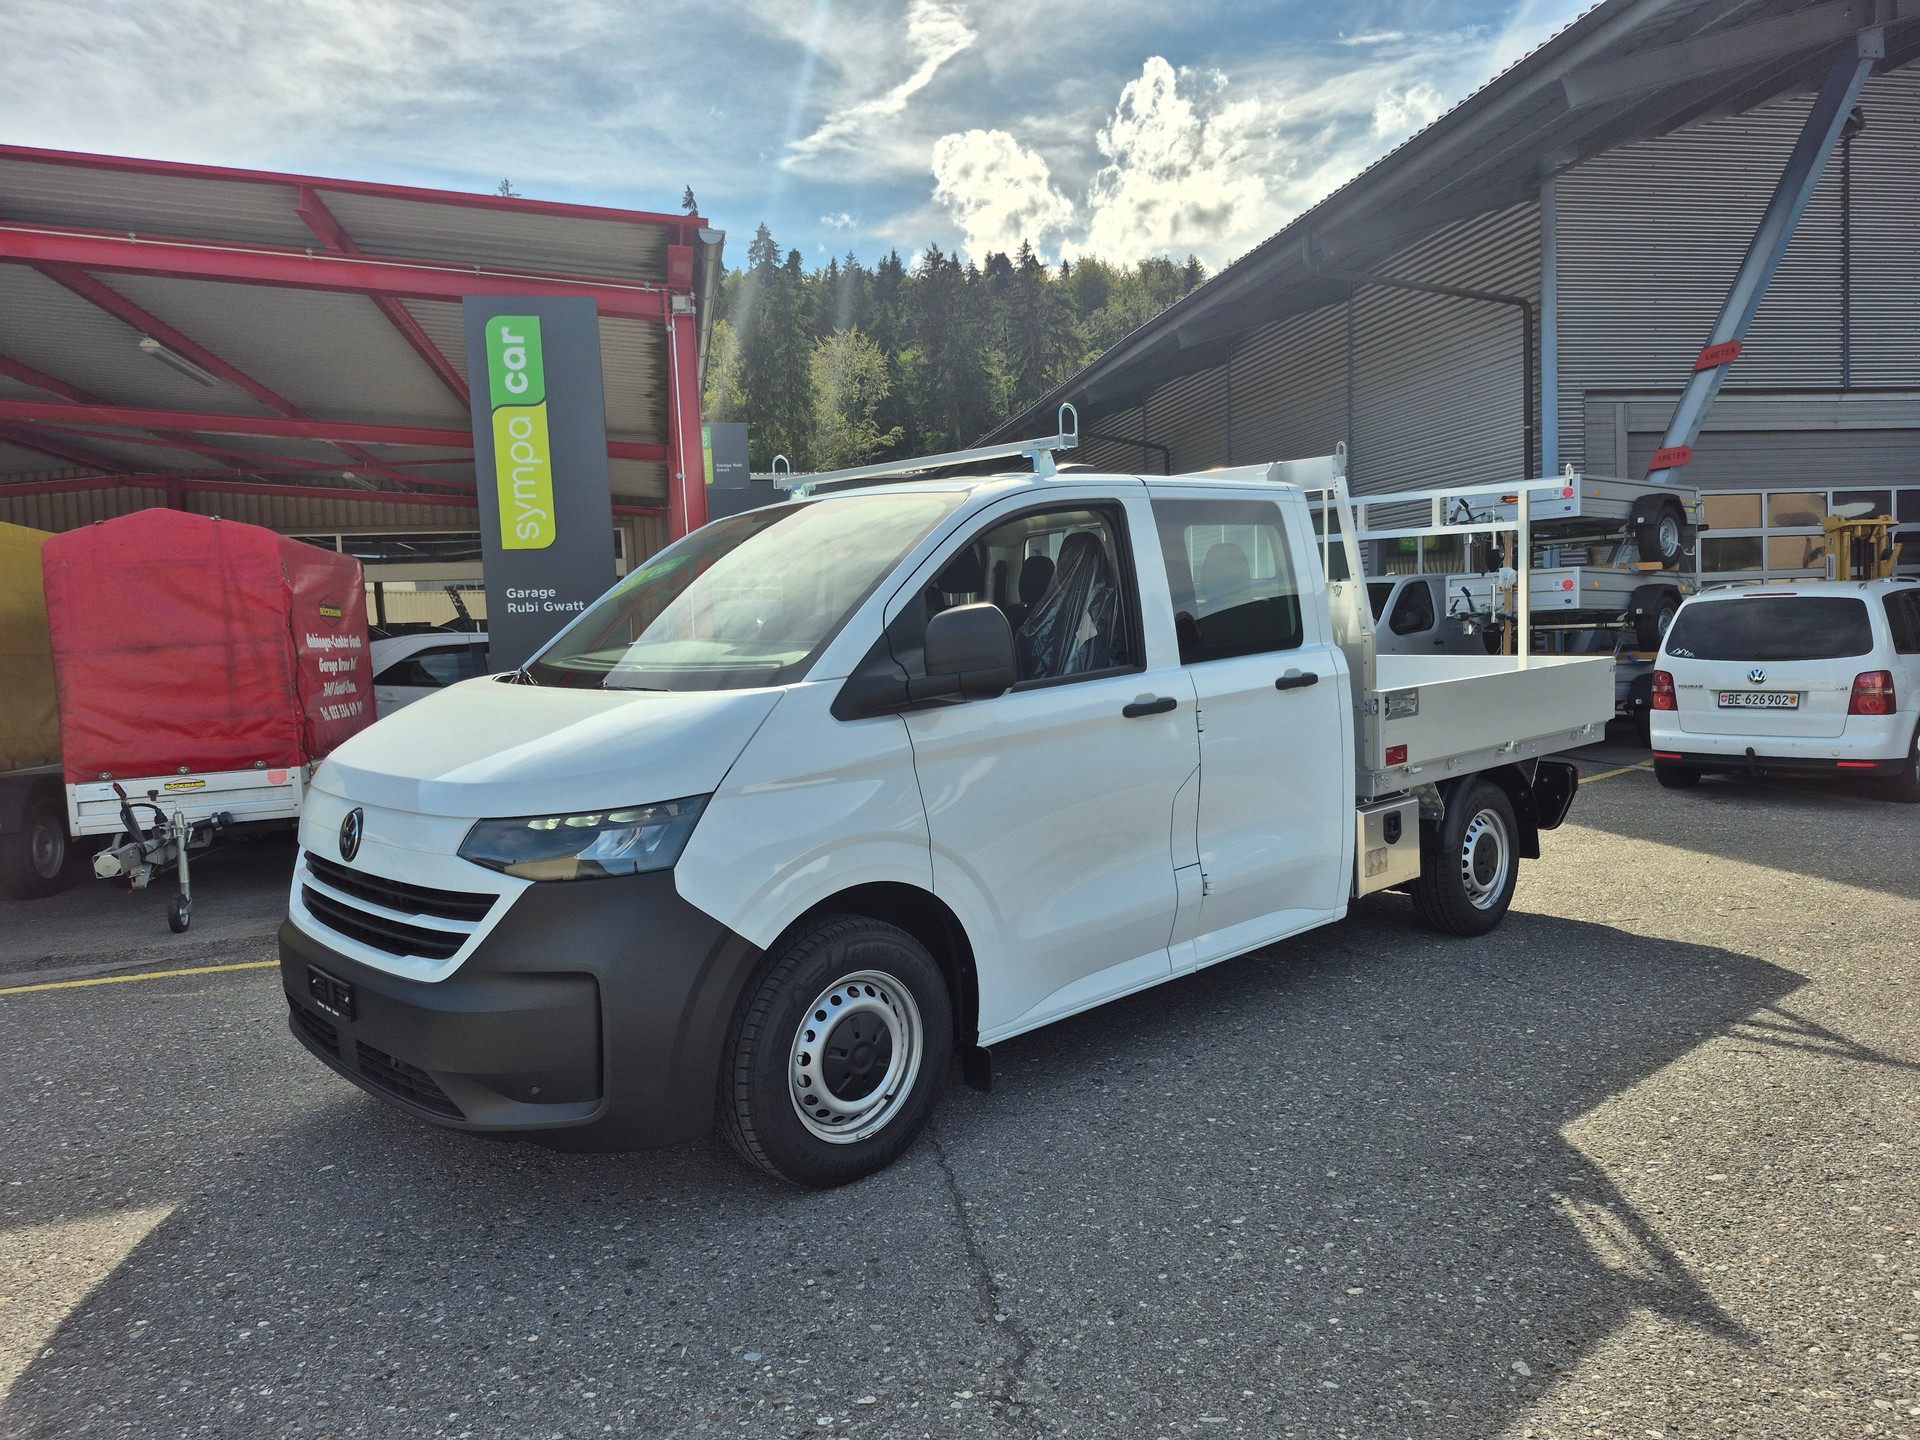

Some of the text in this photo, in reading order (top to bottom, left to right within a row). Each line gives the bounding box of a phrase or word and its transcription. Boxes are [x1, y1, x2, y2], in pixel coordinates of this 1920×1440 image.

[501, 326, 547, 540] sympa car
[506, 588, 556, 599] Garage
[507, 601, 584, 613] Rubi Gwatt
[319, 657, 338, 676] Garage
[165, 781, 205, 789] BÖCKMANN
